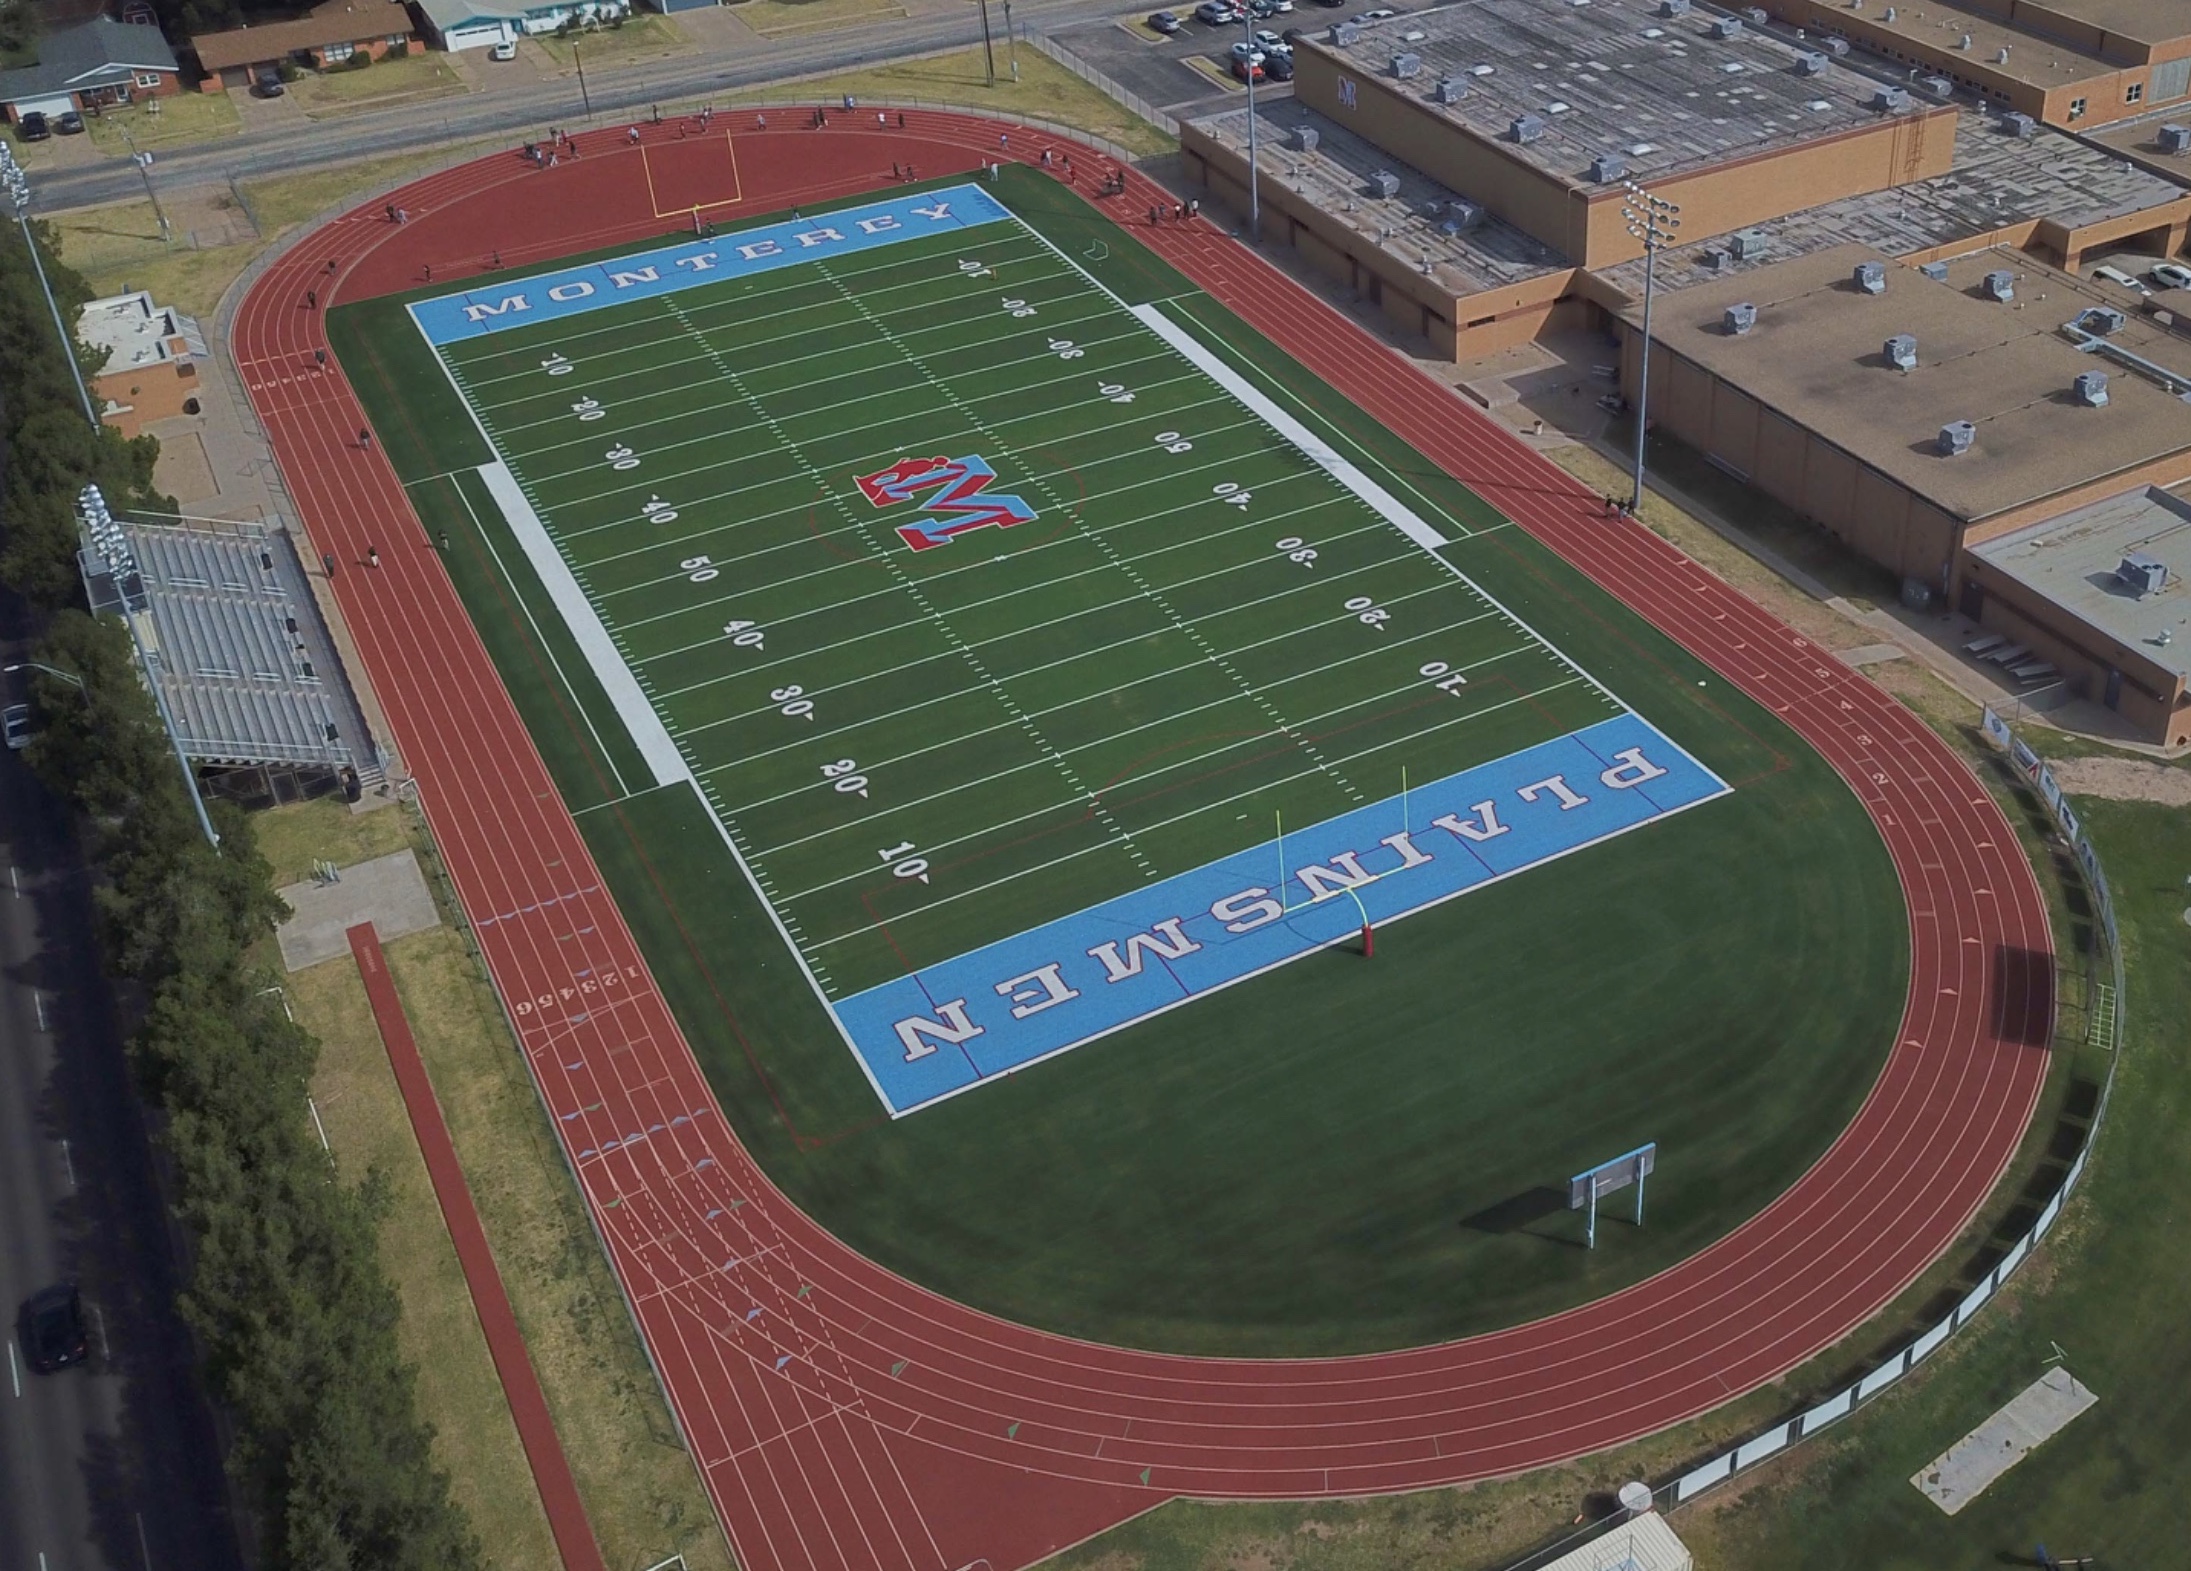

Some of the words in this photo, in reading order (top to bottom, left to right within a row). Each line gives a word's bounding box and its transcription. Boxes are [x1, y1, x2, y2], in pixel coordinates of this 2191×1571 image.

[461, 202, 952, 322] MONTEREY
[959, 261, 992, 277] 10
[1002, 299, 1037, 317] 20
[1049, 341, 1085, 359] 30
[541, 356, 574, 375] 10
[1100, 385, 1135, 402] 40
[571, 400, 606, 420] 20
[1155, 432, 1192, 453] 50
[605, 448, 640, 470] 30
[1213, 482, 1252, 503] 40
[642, 502, 678, 524] 40
[1276, 537, 1317, 562] 30
[680, 555, 719, 582] 50
[1344, 597, 1391, 624] 20
[723, 620, 764, 646] 40
[1419, 662, 1467, 690] 10
[1815, 668, 1830, 679] 5
[770, 685, 814, 715] 30
[1840, 700, 1854, 711] 4
[1857, 734, 1873, 746] 3
[820, 759, 868, 792] 20
[1872, 772, 1889, 785] 2
[1882, 813, 1896, 826] 1
[878, 842, 928, 878] 10
[891, 747, 1669, 1062] PLAINSMEN
[602, 972, 618, 986] 2
[624, 965, 639, 979] 1
[560, 987, 575, 1001] 4
[581, 980, 597, 994] 3
[516, 1001, 532, 1015] 6
[538, 994, 553, 1009] 5
